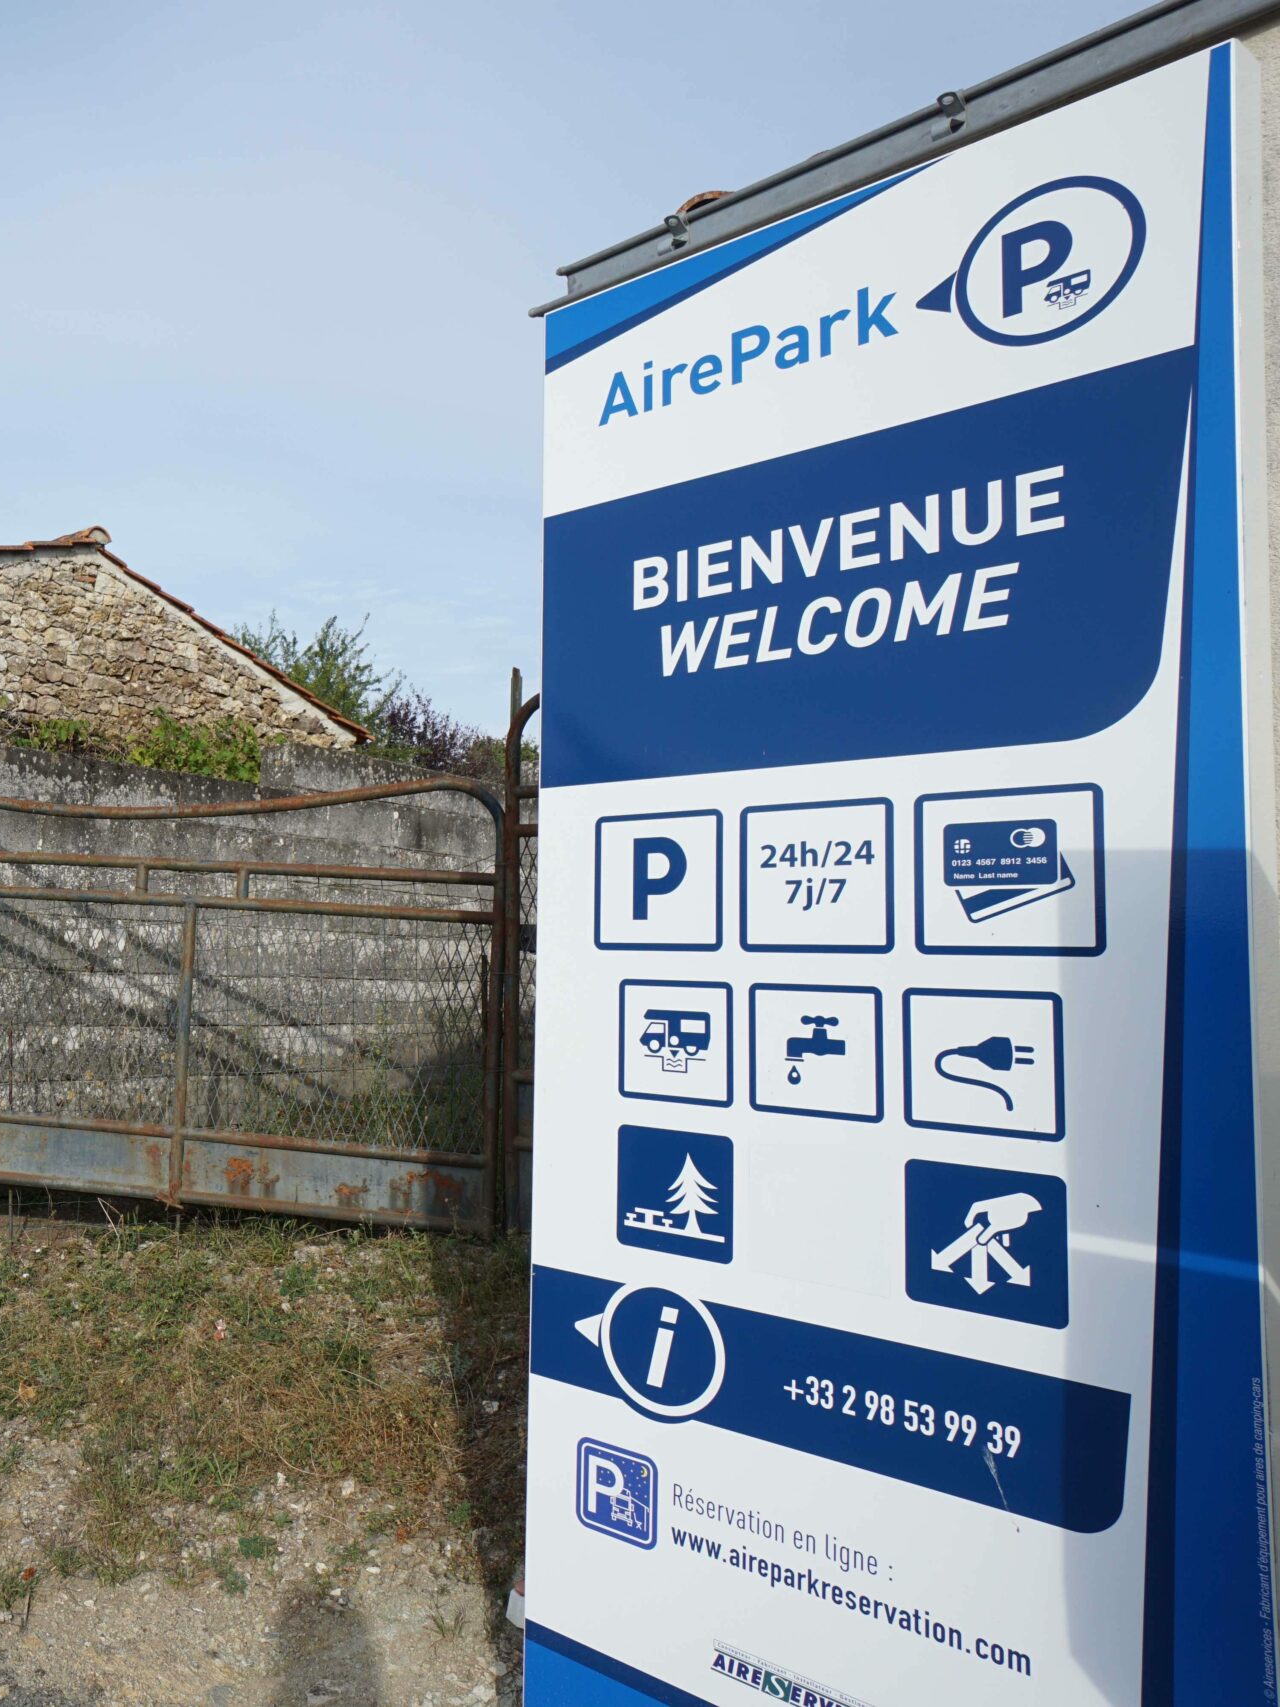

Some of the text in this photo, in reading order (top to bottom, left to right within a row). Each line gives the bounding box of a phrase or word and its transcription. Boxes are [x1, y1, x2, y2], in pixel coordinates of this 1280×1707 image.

[1001, 220, 1073, 319] P
[598, 286, 899, 427] AirePark
[632, 465, 1065, 611] BIENVENUE
[660, 562, 1019, 677] WELCOME
[633, 837, 686, 920] P
[760, 840, 875, 869] 24h/24
[785, 879, 846, 911] 7j/7
[783, 1376, 1021, 1458] +33 2 98 53 99 39
[1251, 1377, 1264, 1441] camping-cars
[1252, 1442, 1264, 1455] de
[1253, 1457, 1265, 1481] aires
[588, 1454, 624, 1514] P
[1255, 1482, 1267, 1506] pour
[673, 1483, 784, 1544] Réservation
[792, 1525, 817, 1555] en
[825, 1533, 878, 1580] ligne
[671, 1524, 1032, 1677] www.aireparkreservation.com
[1259, 1573, 1271, 1619] Fabricant
[1261, 1628, 1275, 1688] Aireservices
